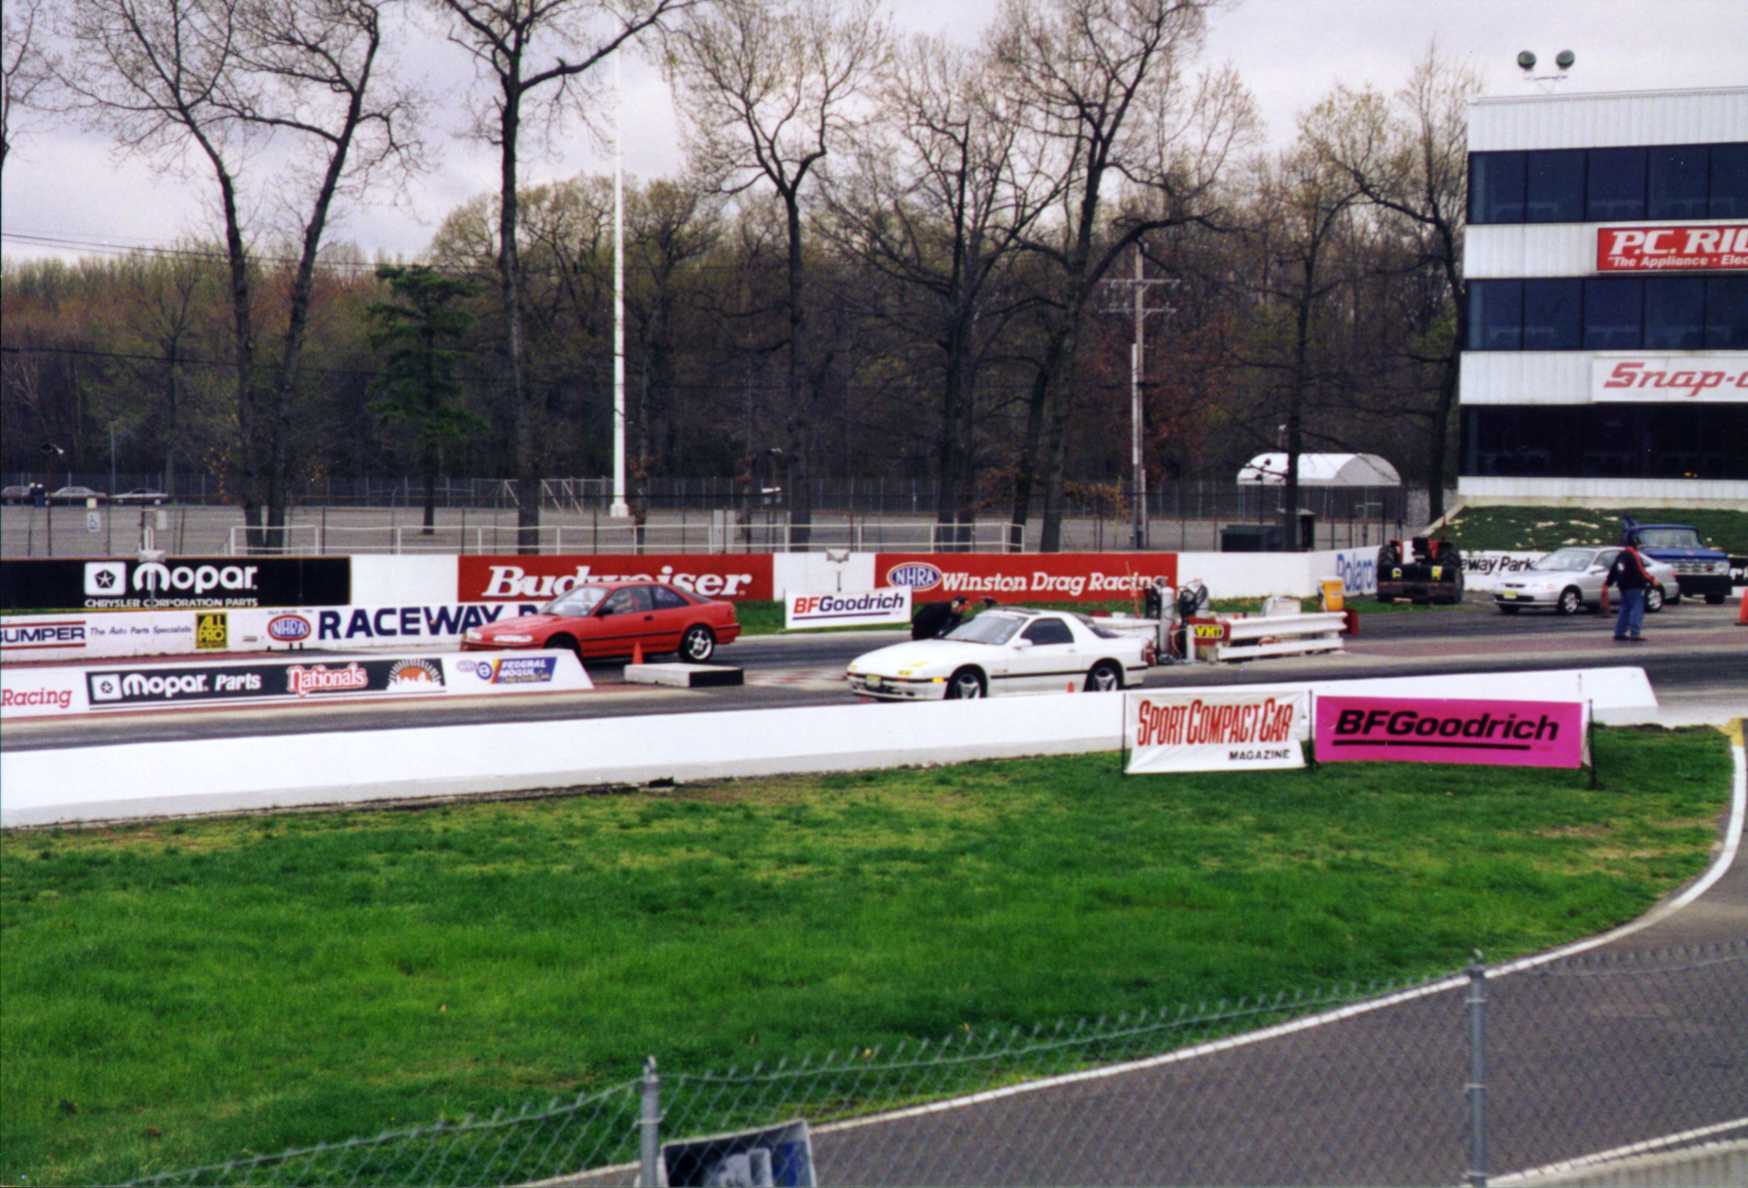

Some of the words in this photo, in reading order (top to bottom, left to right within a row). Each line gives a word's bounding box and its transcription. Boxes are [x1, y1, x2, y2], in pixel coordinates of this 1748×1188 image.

[1641, 255, 1708, 268] Appliance
[1499, 556, 1536, 573] Park
[893, 568, 940, 587] NHRA
[942, 572, 1026, 591] Winston
[1031, 572, 1084, 595] Drag
[85, 598, 140, 608] CHRYSLER
[143, 598, 223, 608] CORPORATION
[225, 598, 258, 608] PARTS
[793, 594, 905, 614] BFGoodrich
[318, 604, 504, 641] RACEWAY
[0, 626, 86, 643] UMPER
[214, 672, 262, 692] Parts
[286, 663, 368, 697] Nationals
[1, 688, 72, 709] Racing
[1334, 709, 1559, 741] BFGoodrich
[1229, 749, 1290, 760] MAGAZINE
